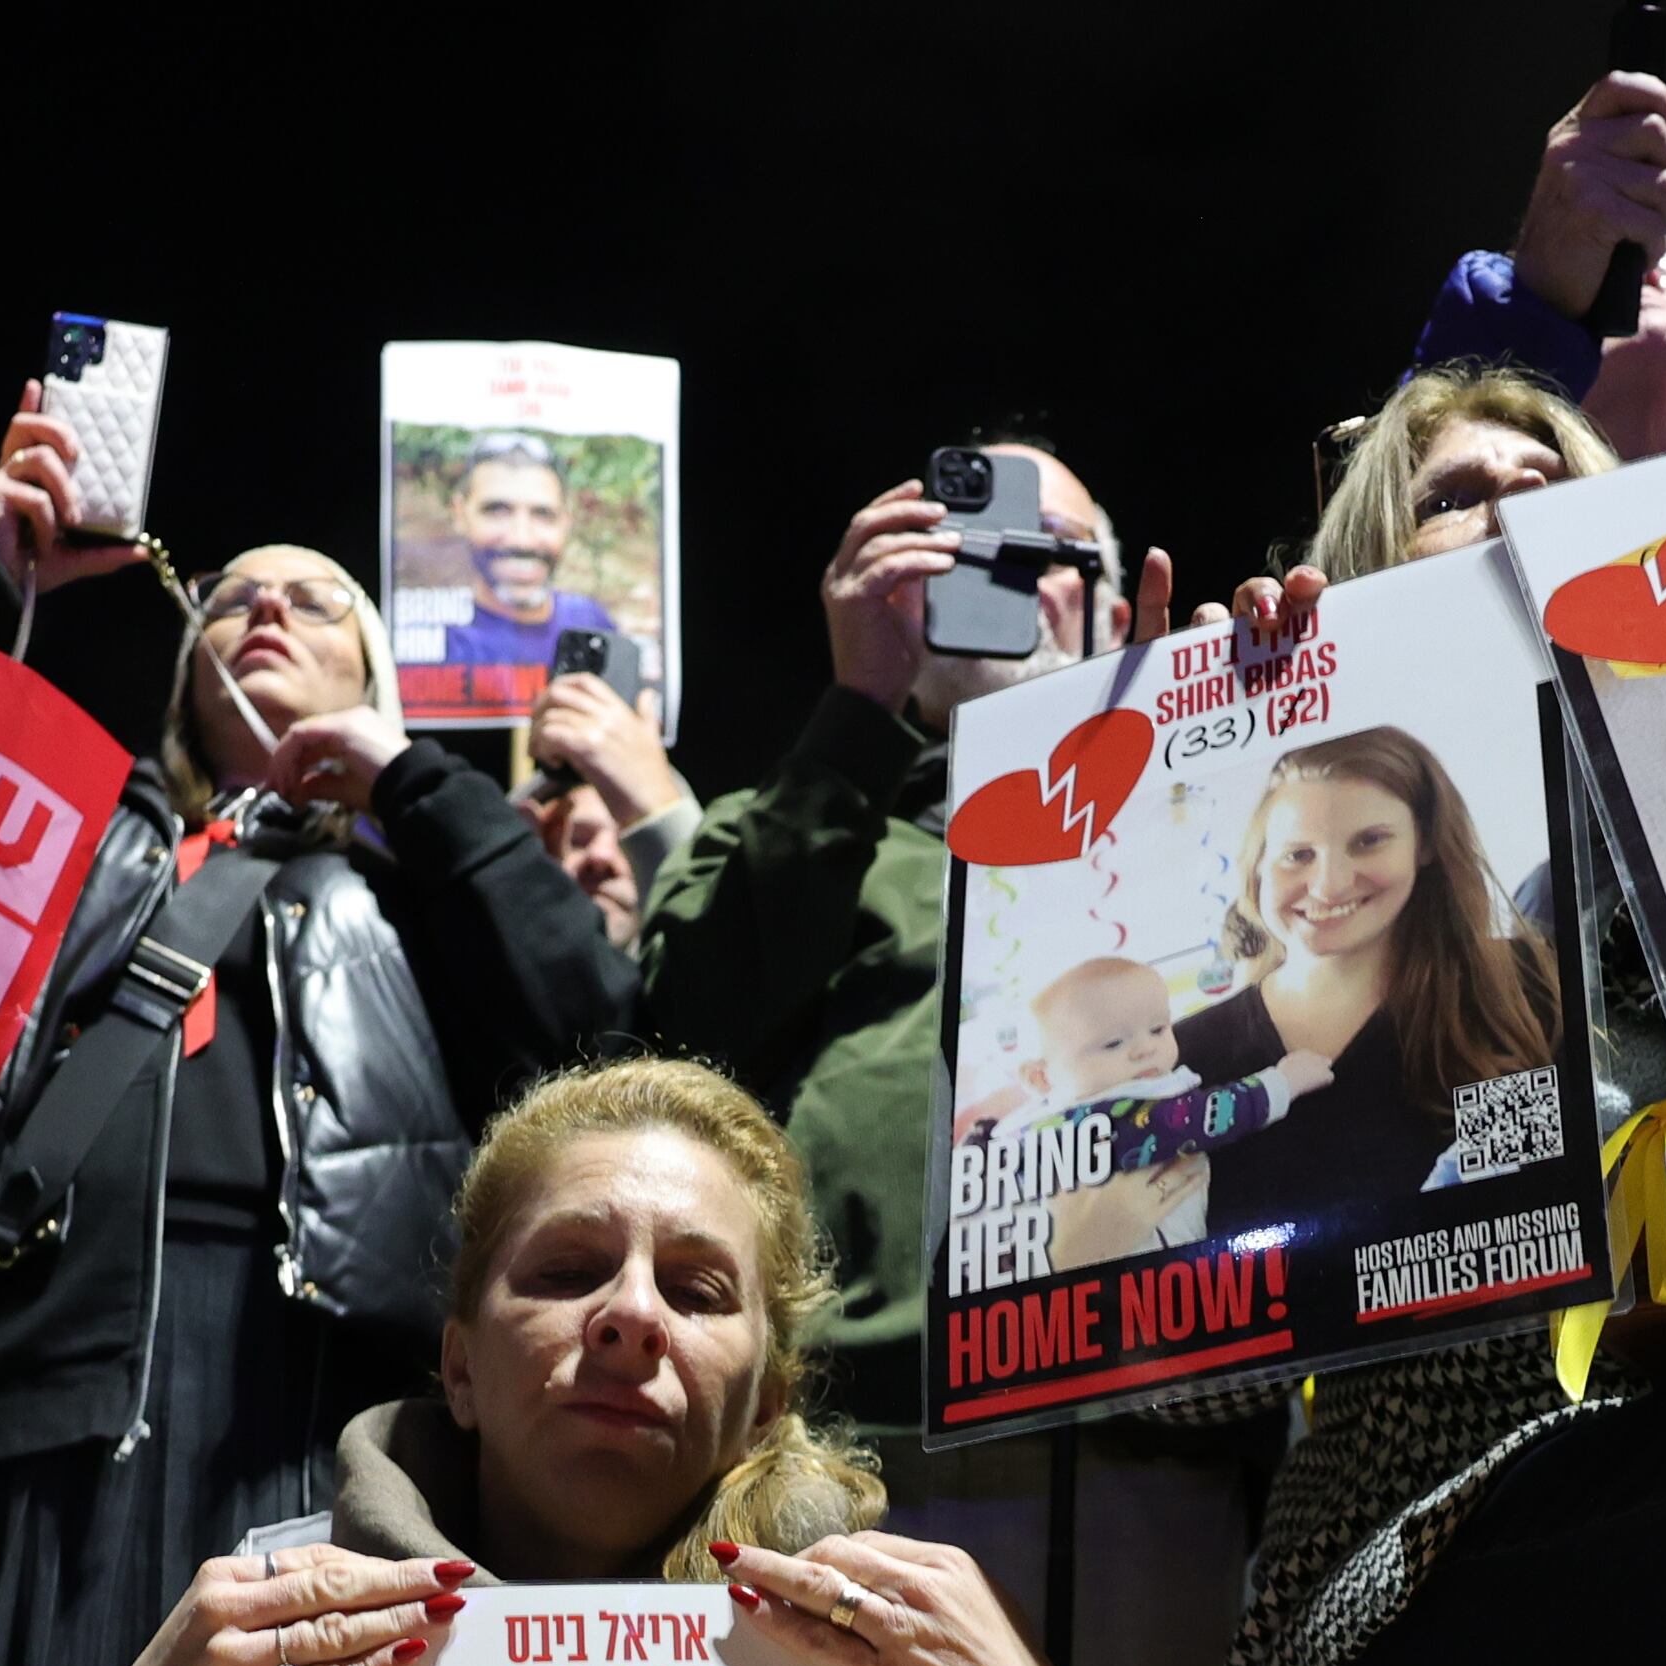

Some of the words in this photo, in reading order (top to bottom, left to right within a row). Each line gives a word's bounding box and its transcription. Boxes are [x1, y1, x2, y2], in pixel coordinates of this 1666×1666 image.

[1156, 671, 1236, 726] SHIRI
[1244, 641, 1337, 699] BIBAS
[1171, 635, 1240, 680] ביבס
[1164, 708, 1255, 769] (33)
[1266, 681, 1329, 737] (32)
[950, 1113, 1113, 1220] BRING
[948, 1201, 1052, 1299] HER
[1354, 1229, 1449, 1275] HOSTAGES
[1454, 1220, 1491, 1254] AND
[1494, 1201, 1581, 1246] MISSING
[1356, 1252, 1479, 1315] FAMILIES
[1484, 1229, 1585, 1288] FORUM
[949, 1280, 1103, 1390] HOME
[1120, 1246, 1290, 1351] NOW!
[504, 1614, 588, 1663] ביבס
[599, 1610, 710, 1661] אריאל
